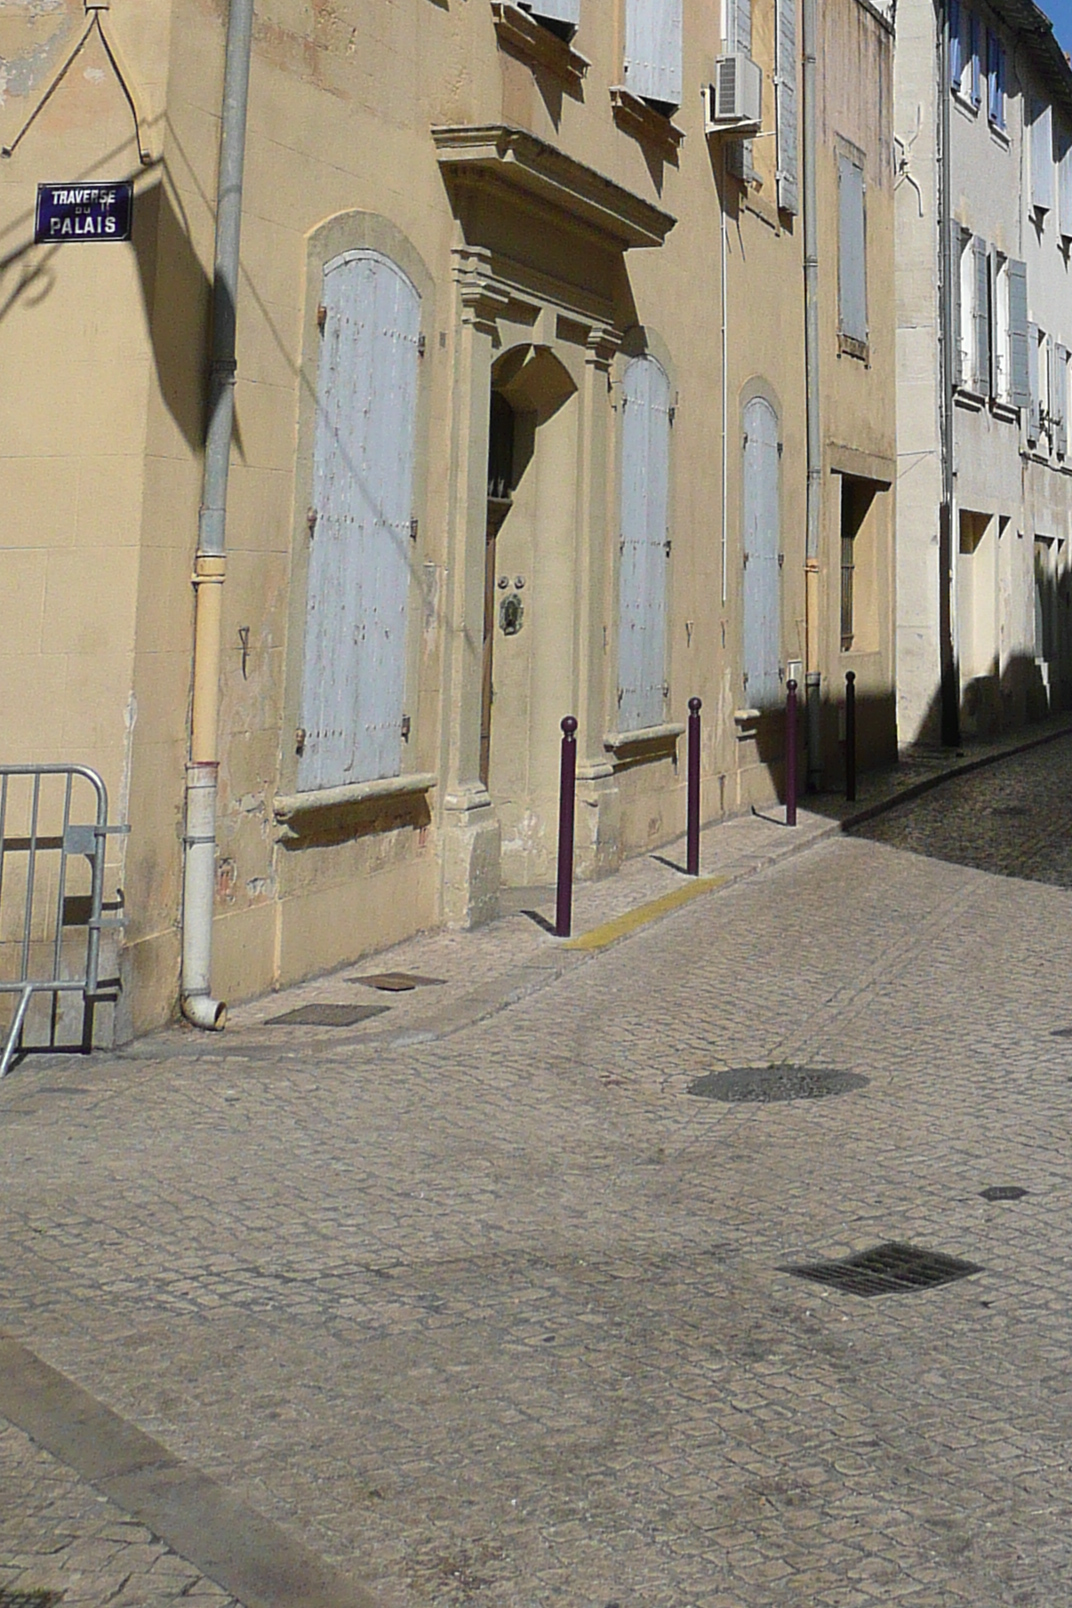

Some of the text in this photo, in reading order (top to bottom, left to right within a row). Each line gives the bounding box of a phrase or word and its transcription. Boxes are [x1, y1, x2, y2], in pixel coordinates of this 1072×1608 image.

[51, 189, 117, 205] TRAVERSE
[75, 206, 91, 214] DU
[50, 216, 116, 235] PALAIS
